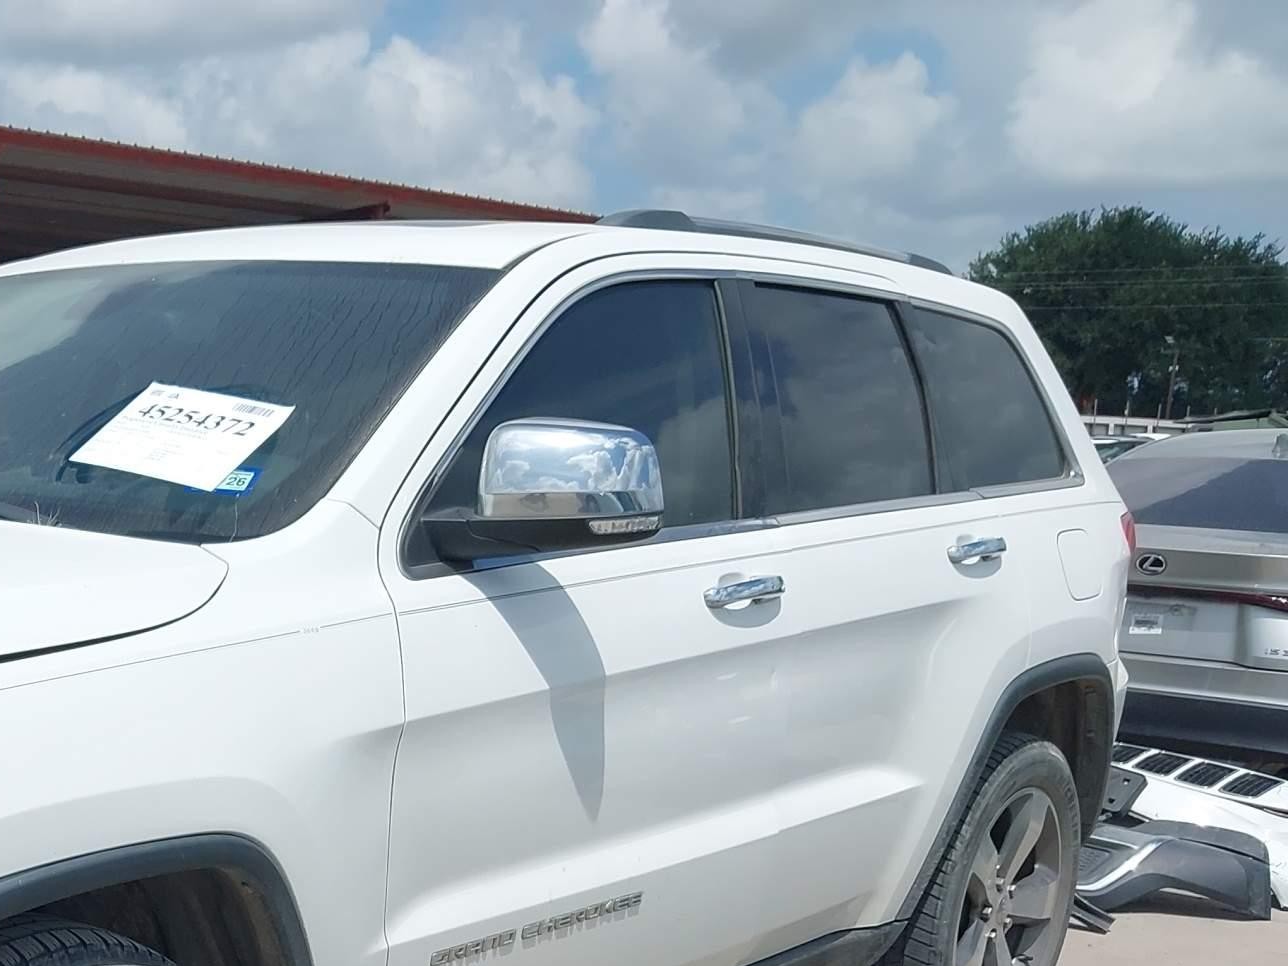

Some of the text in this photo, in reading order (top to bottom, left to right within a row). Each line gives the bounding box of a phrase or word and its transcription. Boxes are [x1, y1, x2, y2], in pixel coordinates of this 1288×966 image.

[138, 403, 256, 437] 45254372
[226, 476, 247, 487] 26
[520, 891, 643, 959] CHEROKEE
